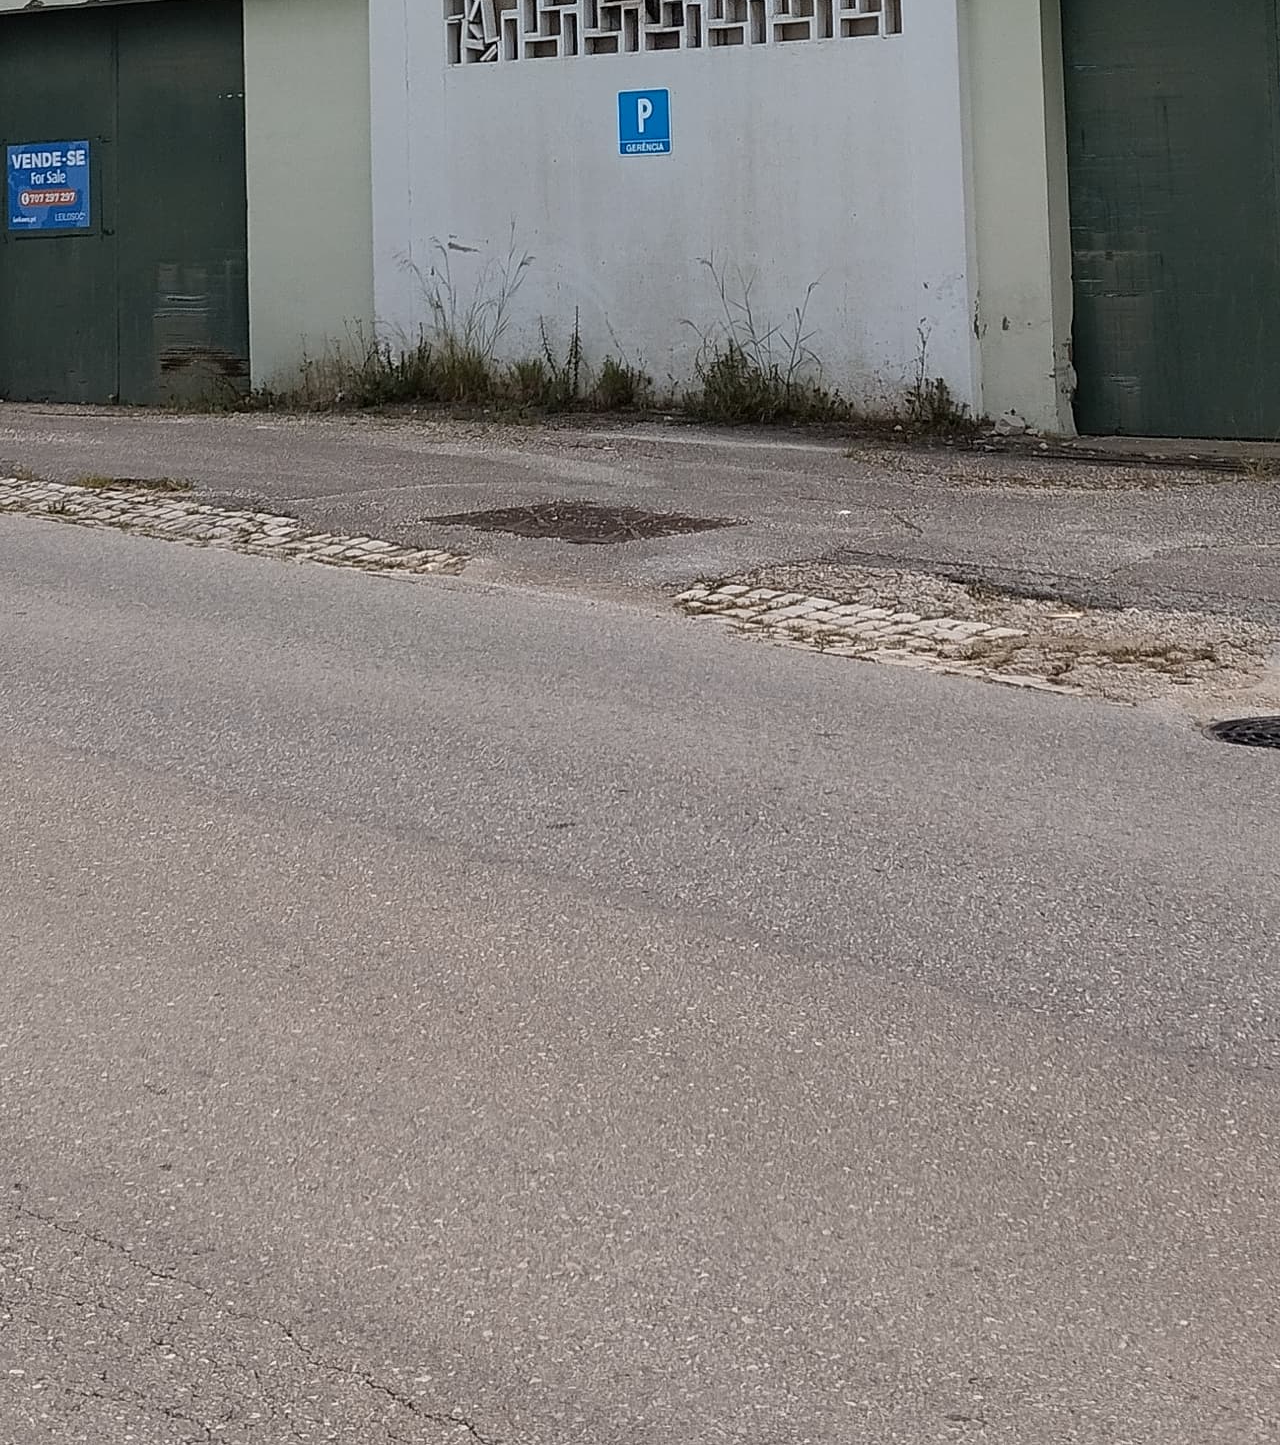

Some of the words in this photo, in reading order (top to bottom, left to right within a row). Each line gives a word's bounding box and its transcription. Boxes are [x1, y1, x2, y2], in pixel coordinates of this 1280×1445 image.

[637, 98, 653, 133] P
[625, 142, 664, 152] GERÊNCIA
[12, 150, 86, 169] VENDE-SE
[31, 172, 45, 185] For
[46, 169, 66, 184] Sale
